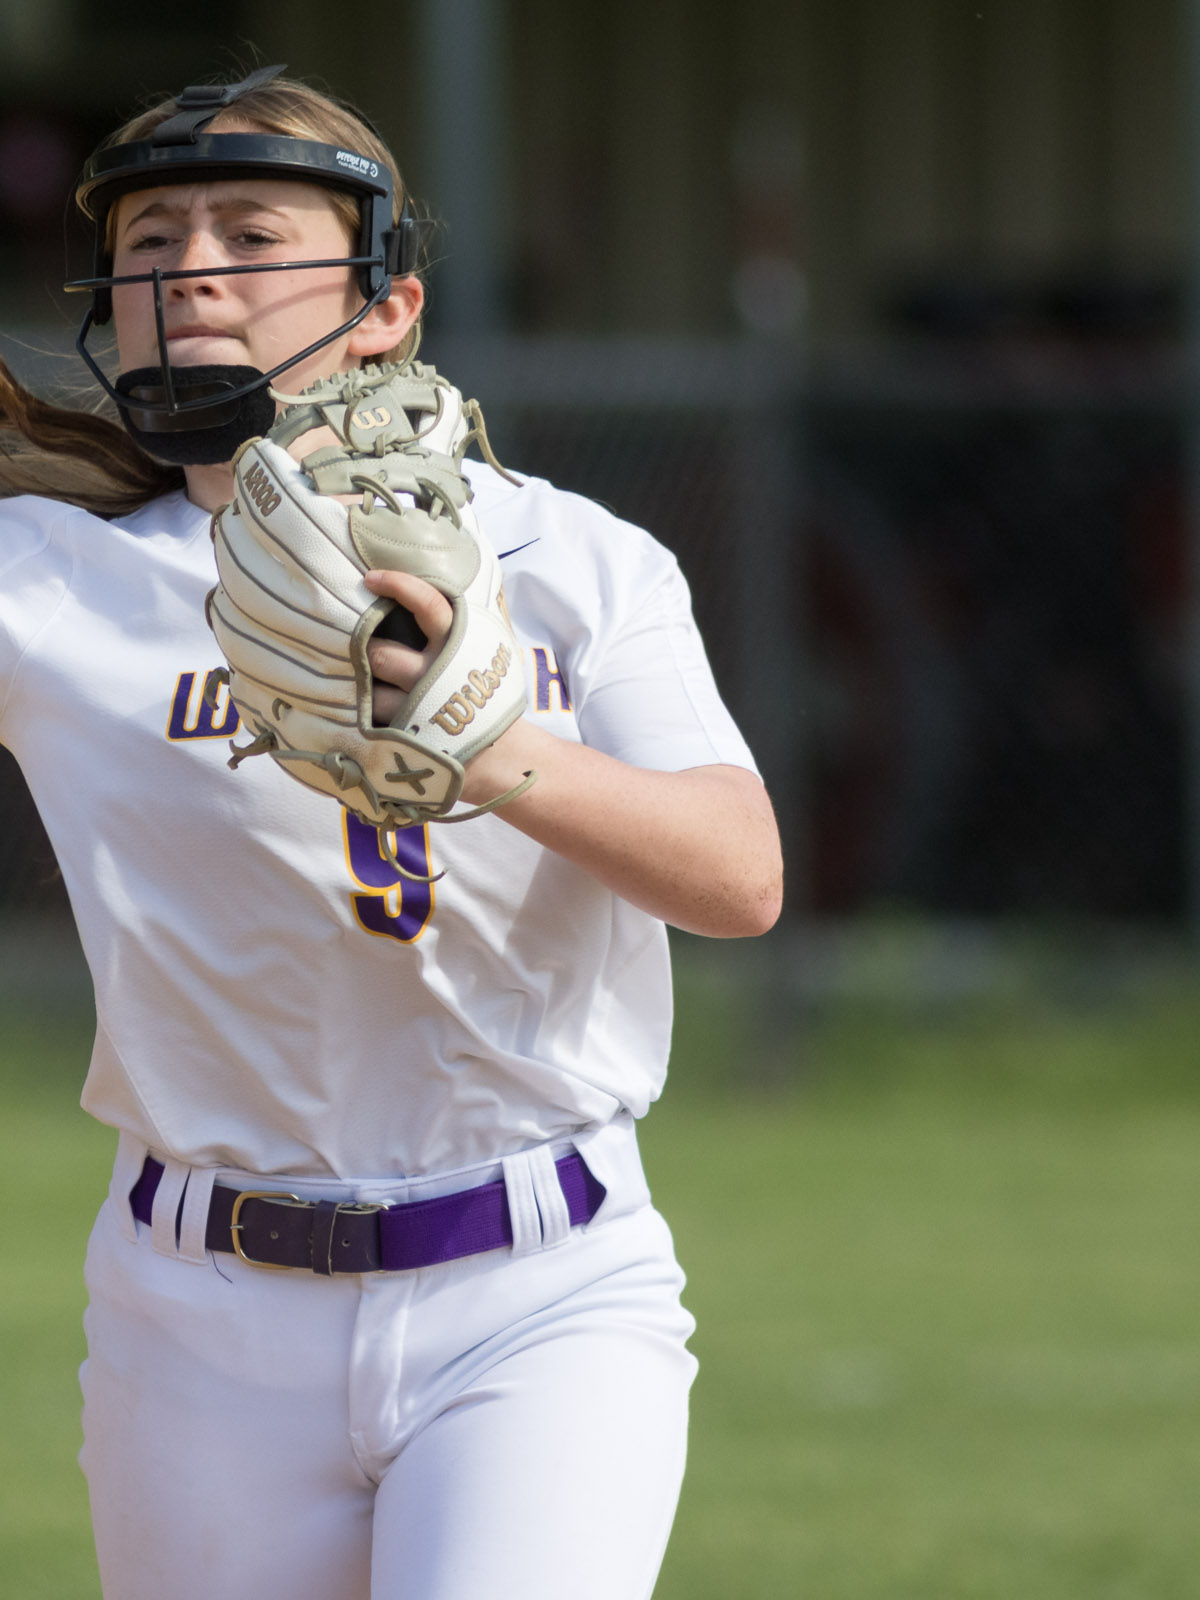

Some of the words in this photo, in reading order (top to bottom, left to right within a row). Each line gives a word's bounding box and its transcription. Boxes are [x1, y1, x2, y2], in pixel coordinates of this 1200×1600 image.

[242, 460, 282, 517] A2000
[429, 642, 512, 736] Wilson
[341, 806, 436, 944] 9
